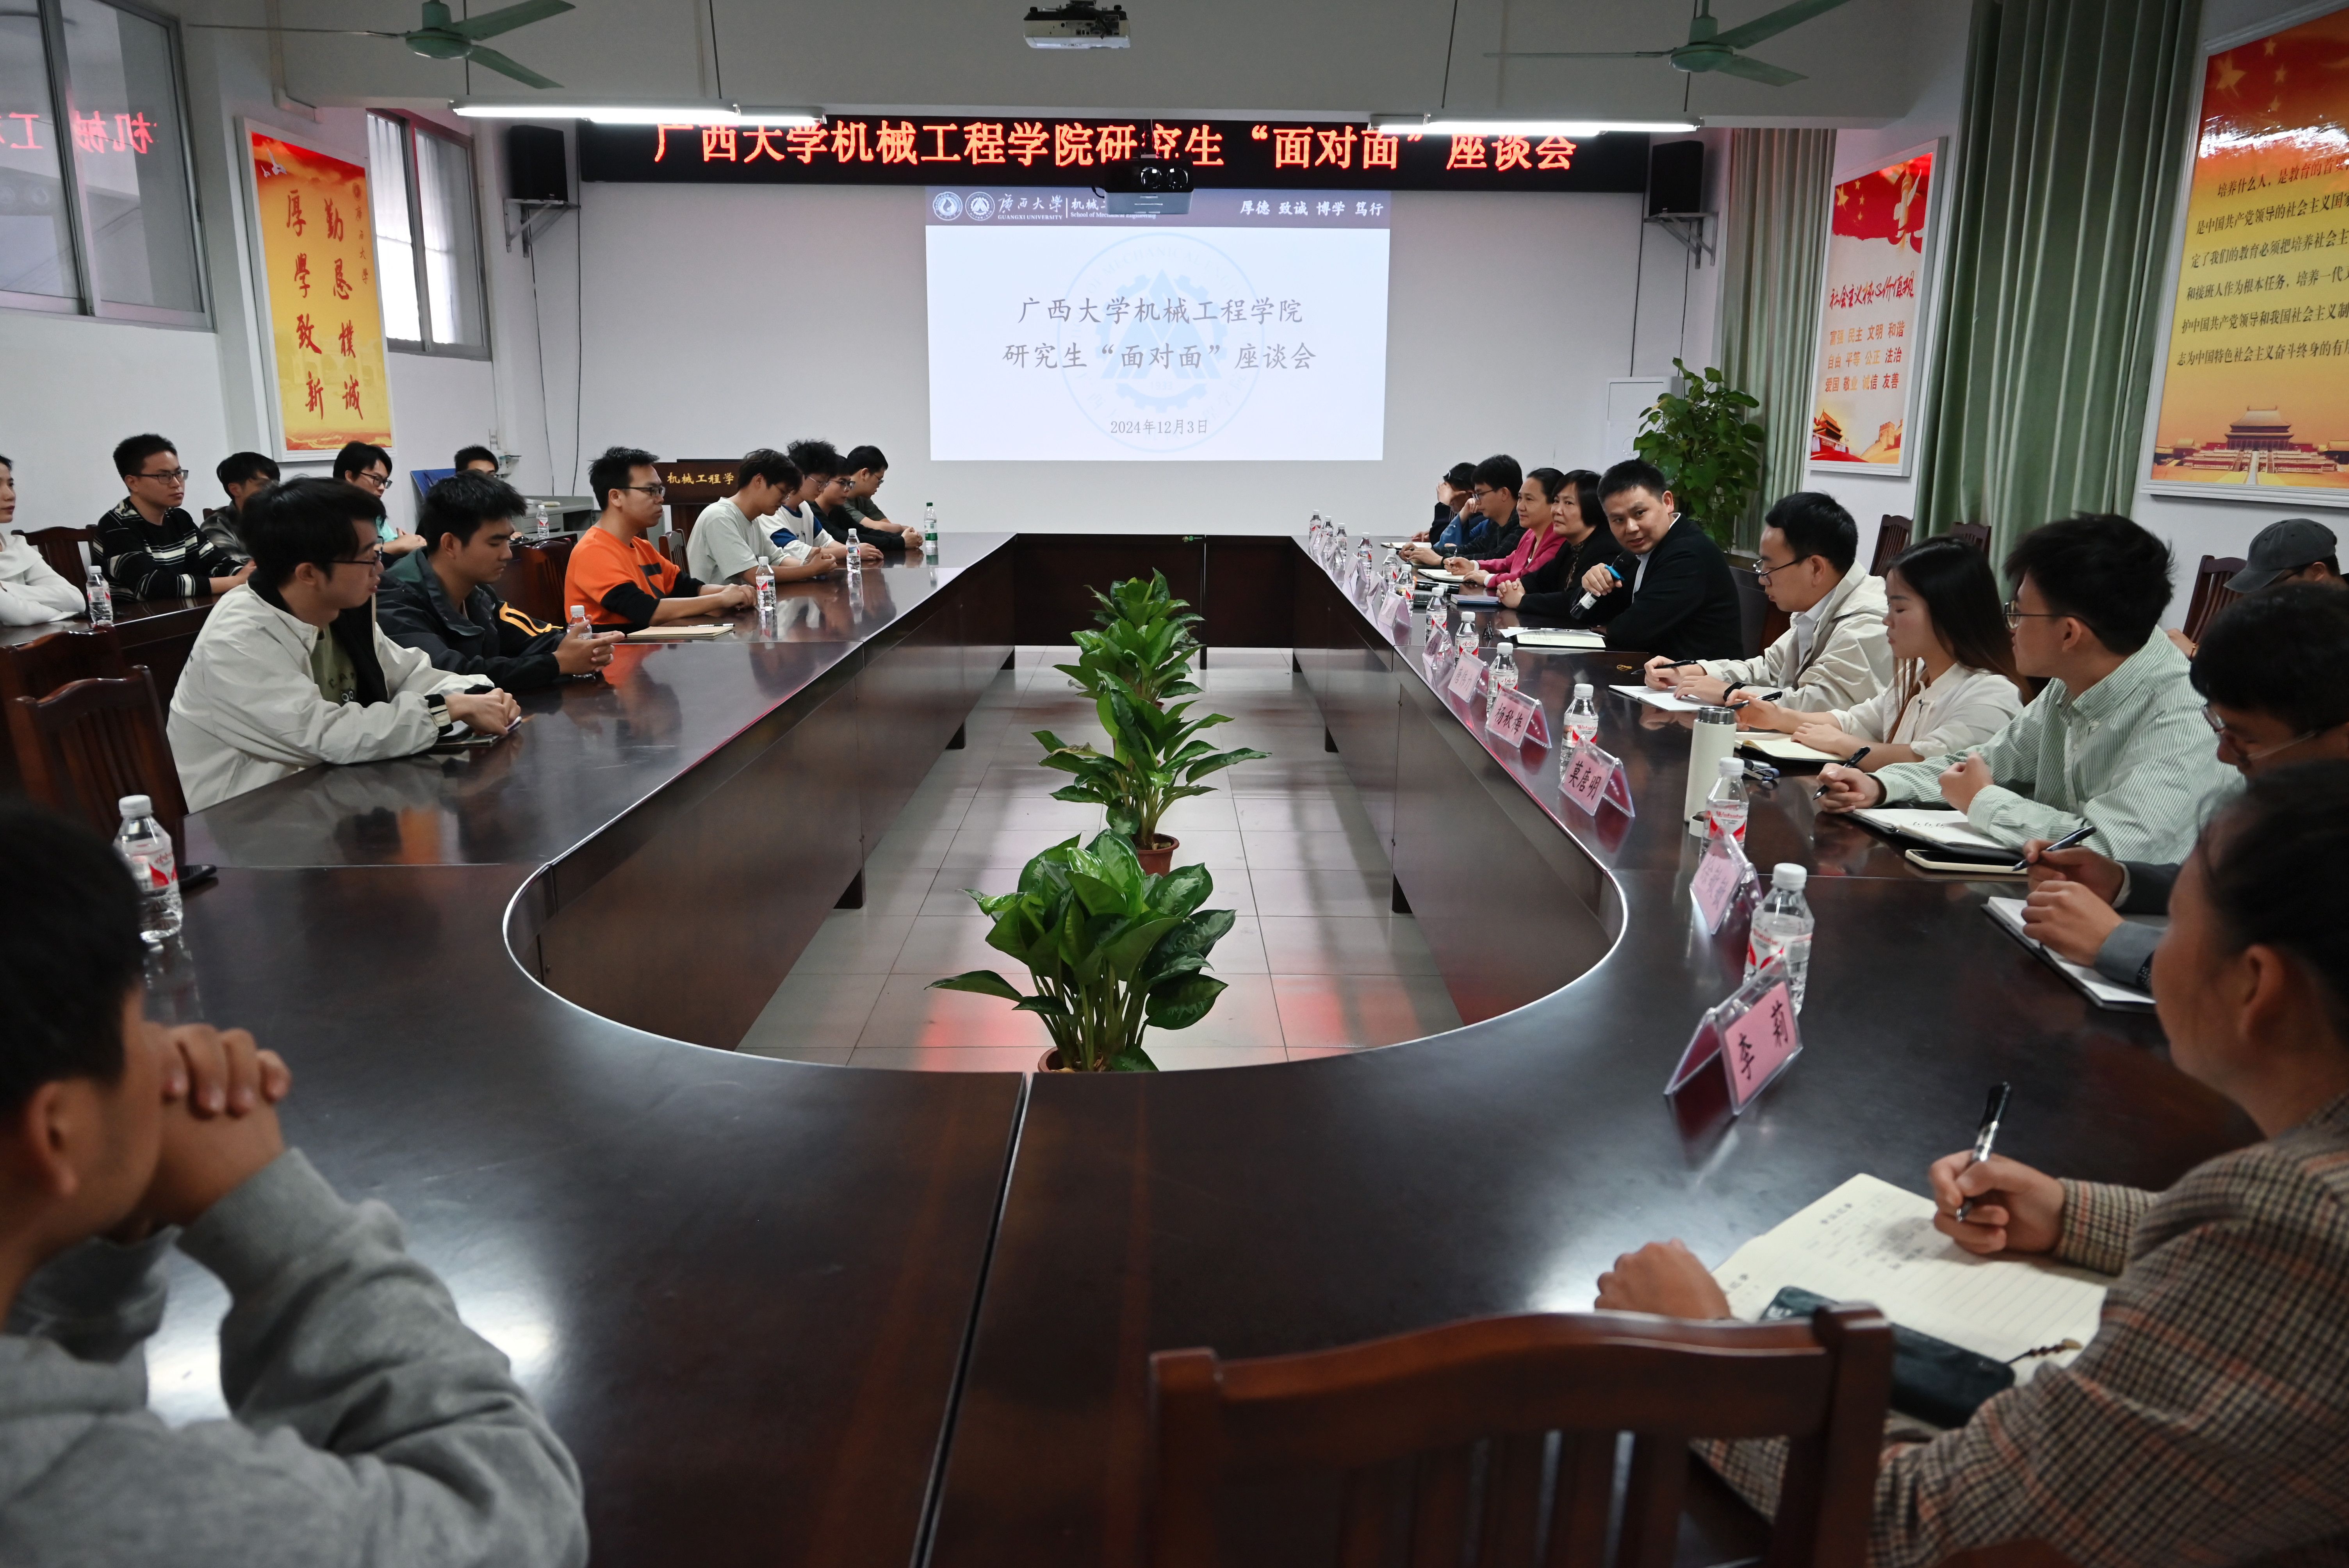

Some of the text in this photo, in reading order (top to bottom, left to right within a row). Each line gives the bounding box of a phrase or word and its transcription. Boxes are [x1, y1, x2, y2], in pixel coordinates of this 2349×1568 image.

[1240, 201, 1384, 216] 厚德 致诚 博学 笃行
[1018, 296, 1303, 324] 广西大学机械工程学院
[1830, 321, 1905, 346] 富强 民主 文明 和谐
[1002, 342, 1316, 369] 研究生“面对面”座谈会
[1828, 347, 1902, 370] 自由 平等 公正 法治
[1825, 372, 1899, 392] 爱国 敬业 诚信 友善
[1110, 419, 1208, 435] 2024年12月3日
[667, 472, 734, 485] 机械工程学
[1568, 760, 1602, 800] 莫唐明
